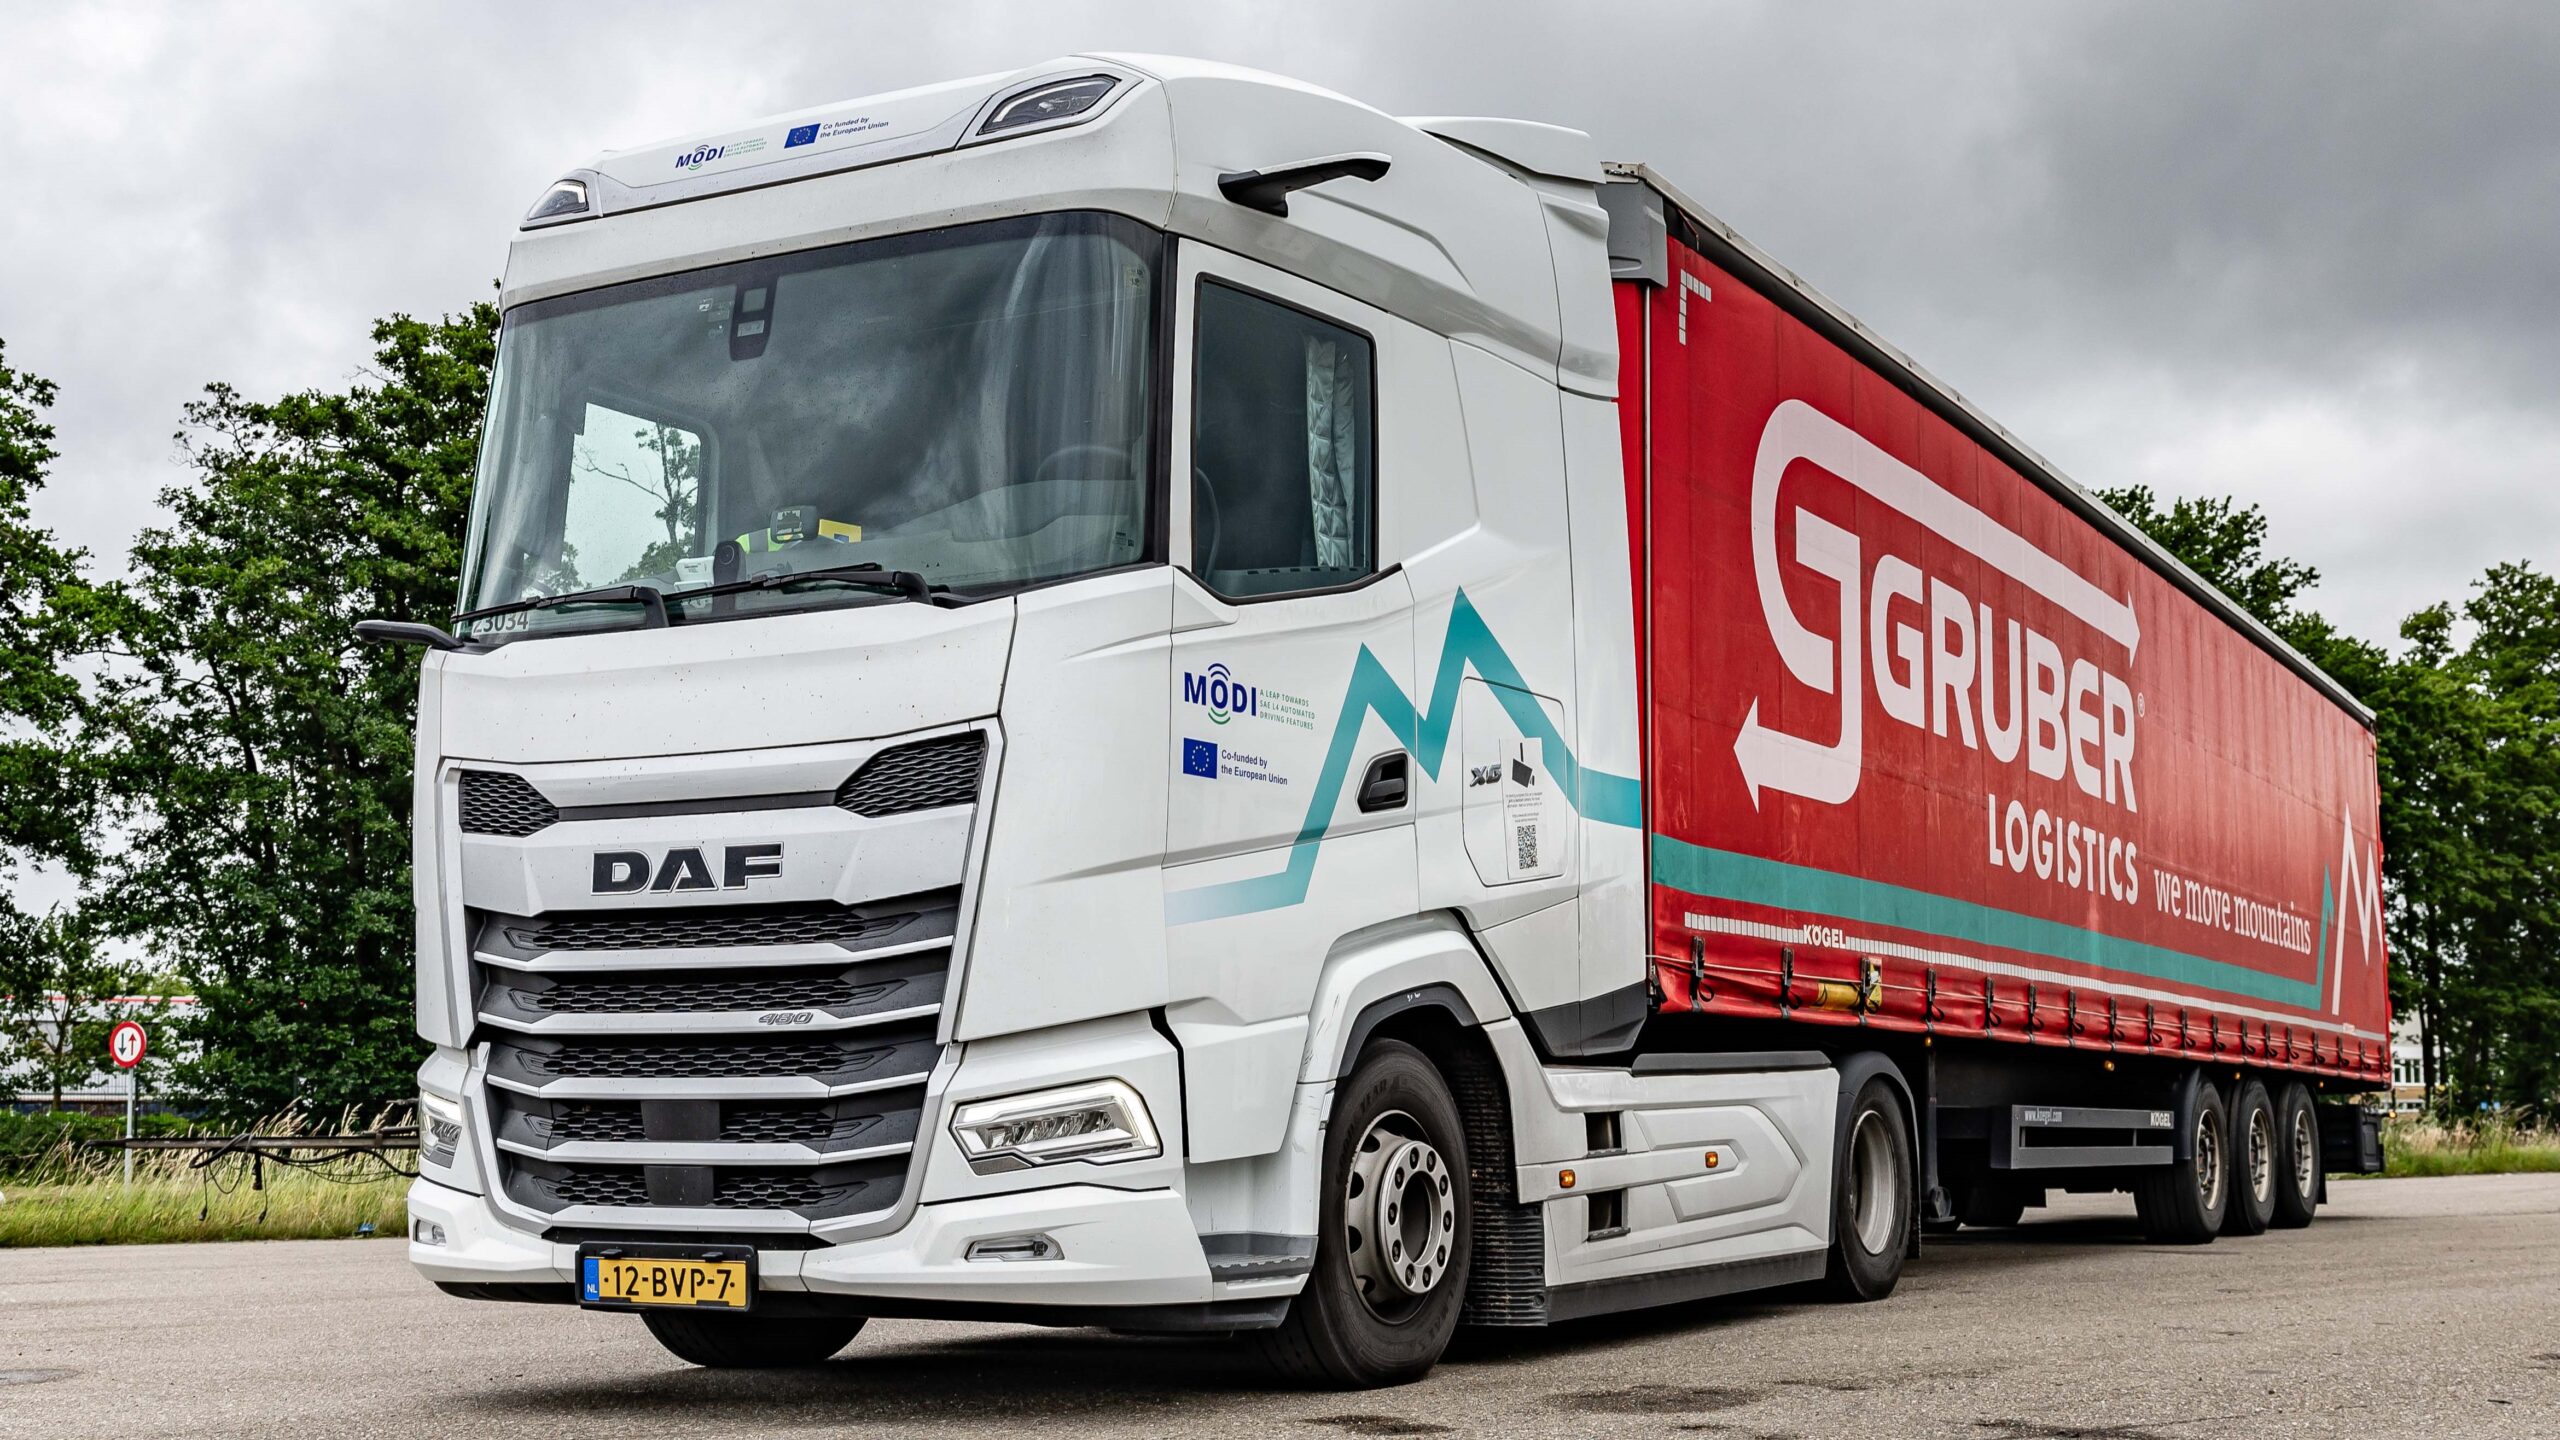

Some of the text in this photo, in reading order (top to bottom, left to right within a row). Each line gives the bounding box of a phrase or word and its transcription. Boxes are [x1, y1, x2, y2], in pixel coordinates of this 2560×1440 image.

[832, 125, 867, 136] European
[868, 121, 889, 130] Union
[675, 146, 725, 168] MODI
[1184, 672, 1257, 717] MODI
[1870, 554, 2137, 813] GRUBER
[1260, 699, 1315, 720] SAE L4 AUTOMATED
[1265, 690, 1280, 700] LEAP
[1281, 694, 1309, 707] TOWARDS
[1260, 711, 1314, 731] DRIVING FEATURES
[1221, 749, 1268, 770] Co-funded by
[1221, 764, 1288, 786] the European Union
[1988, 793, 2138, 905] LOGISTICS
[591, 841, 784, 896] DAF
[2154, 869, 2312, 956] we move mountains
[1803, 924, 1846, 949] KÖGEL
[758, 1012, 814, 1026] 480
[586, 1283, 598, 1293] NL
[613, 1265, 732, 1299] 12-BVP-7
